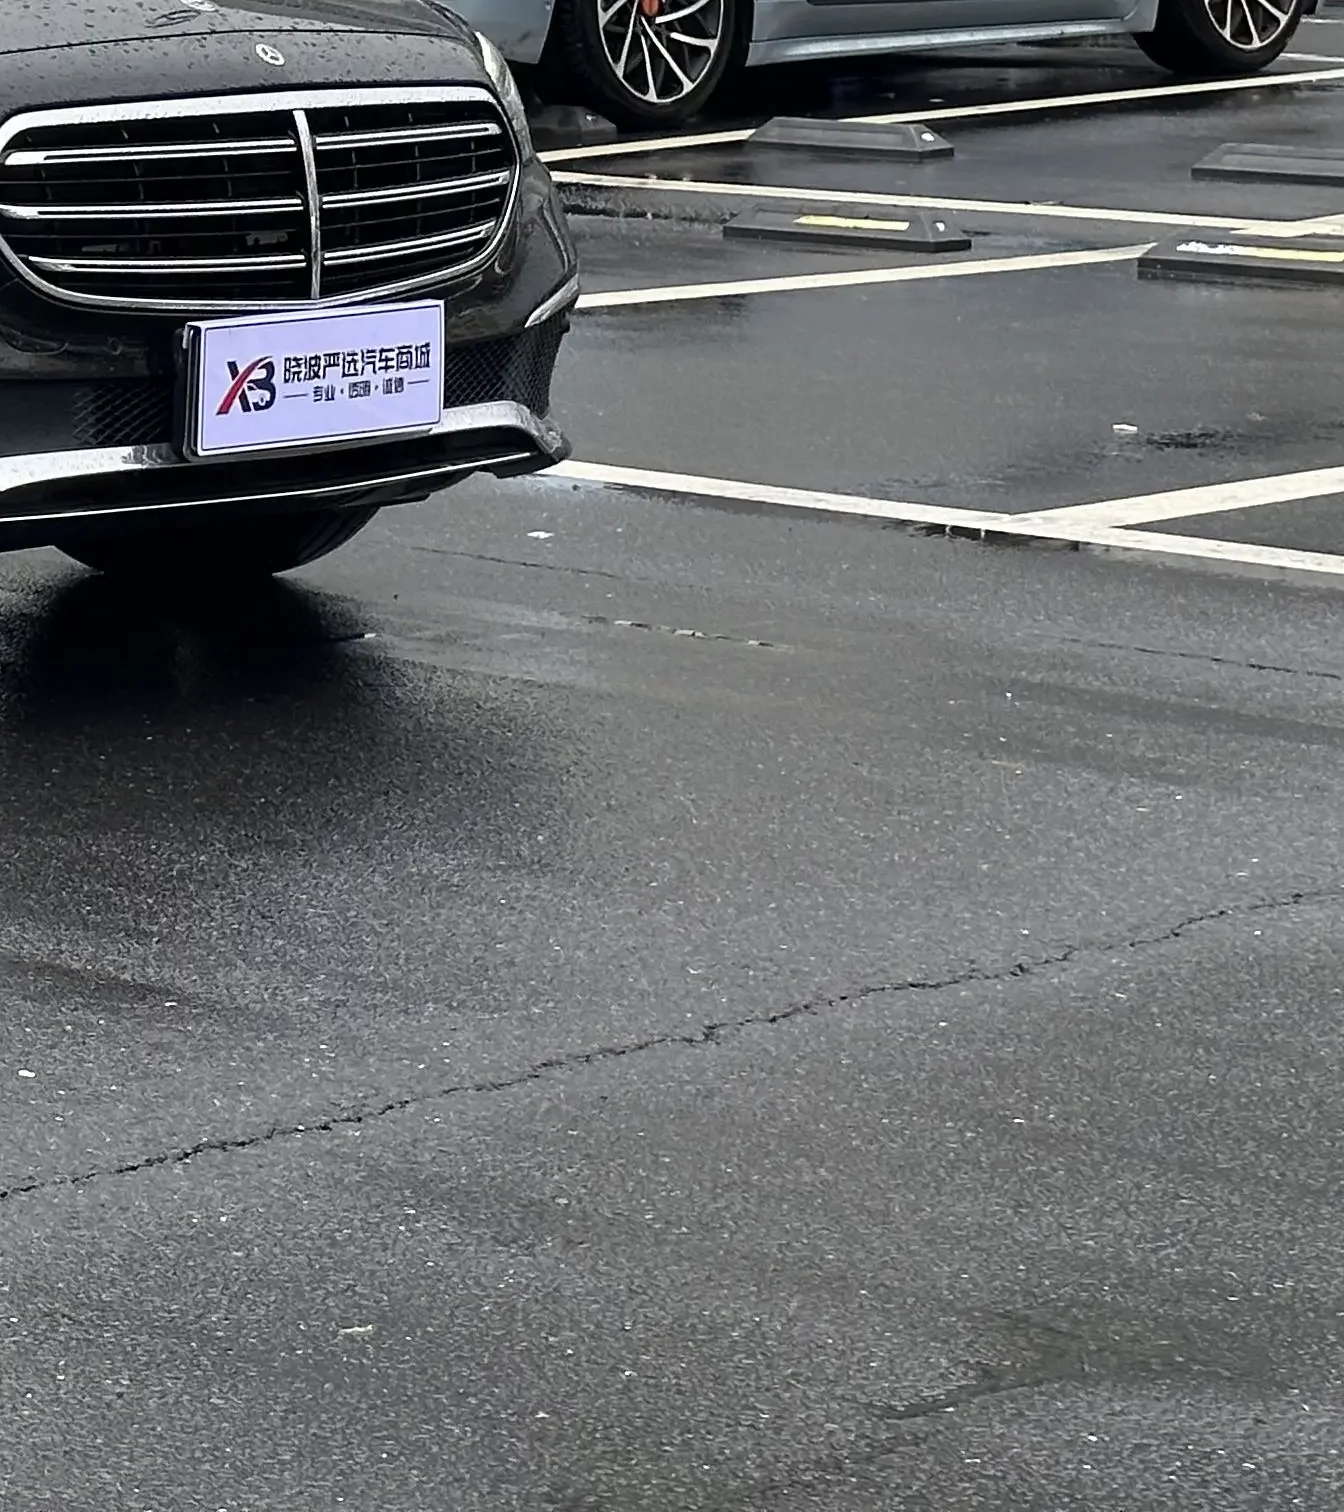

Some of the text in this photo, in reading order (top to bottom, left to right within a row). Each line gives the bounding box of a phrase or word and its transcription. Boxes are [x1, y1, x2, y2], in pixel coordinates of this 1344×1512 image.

[283, 342, 431, 384] 晓波严选汽车商城
